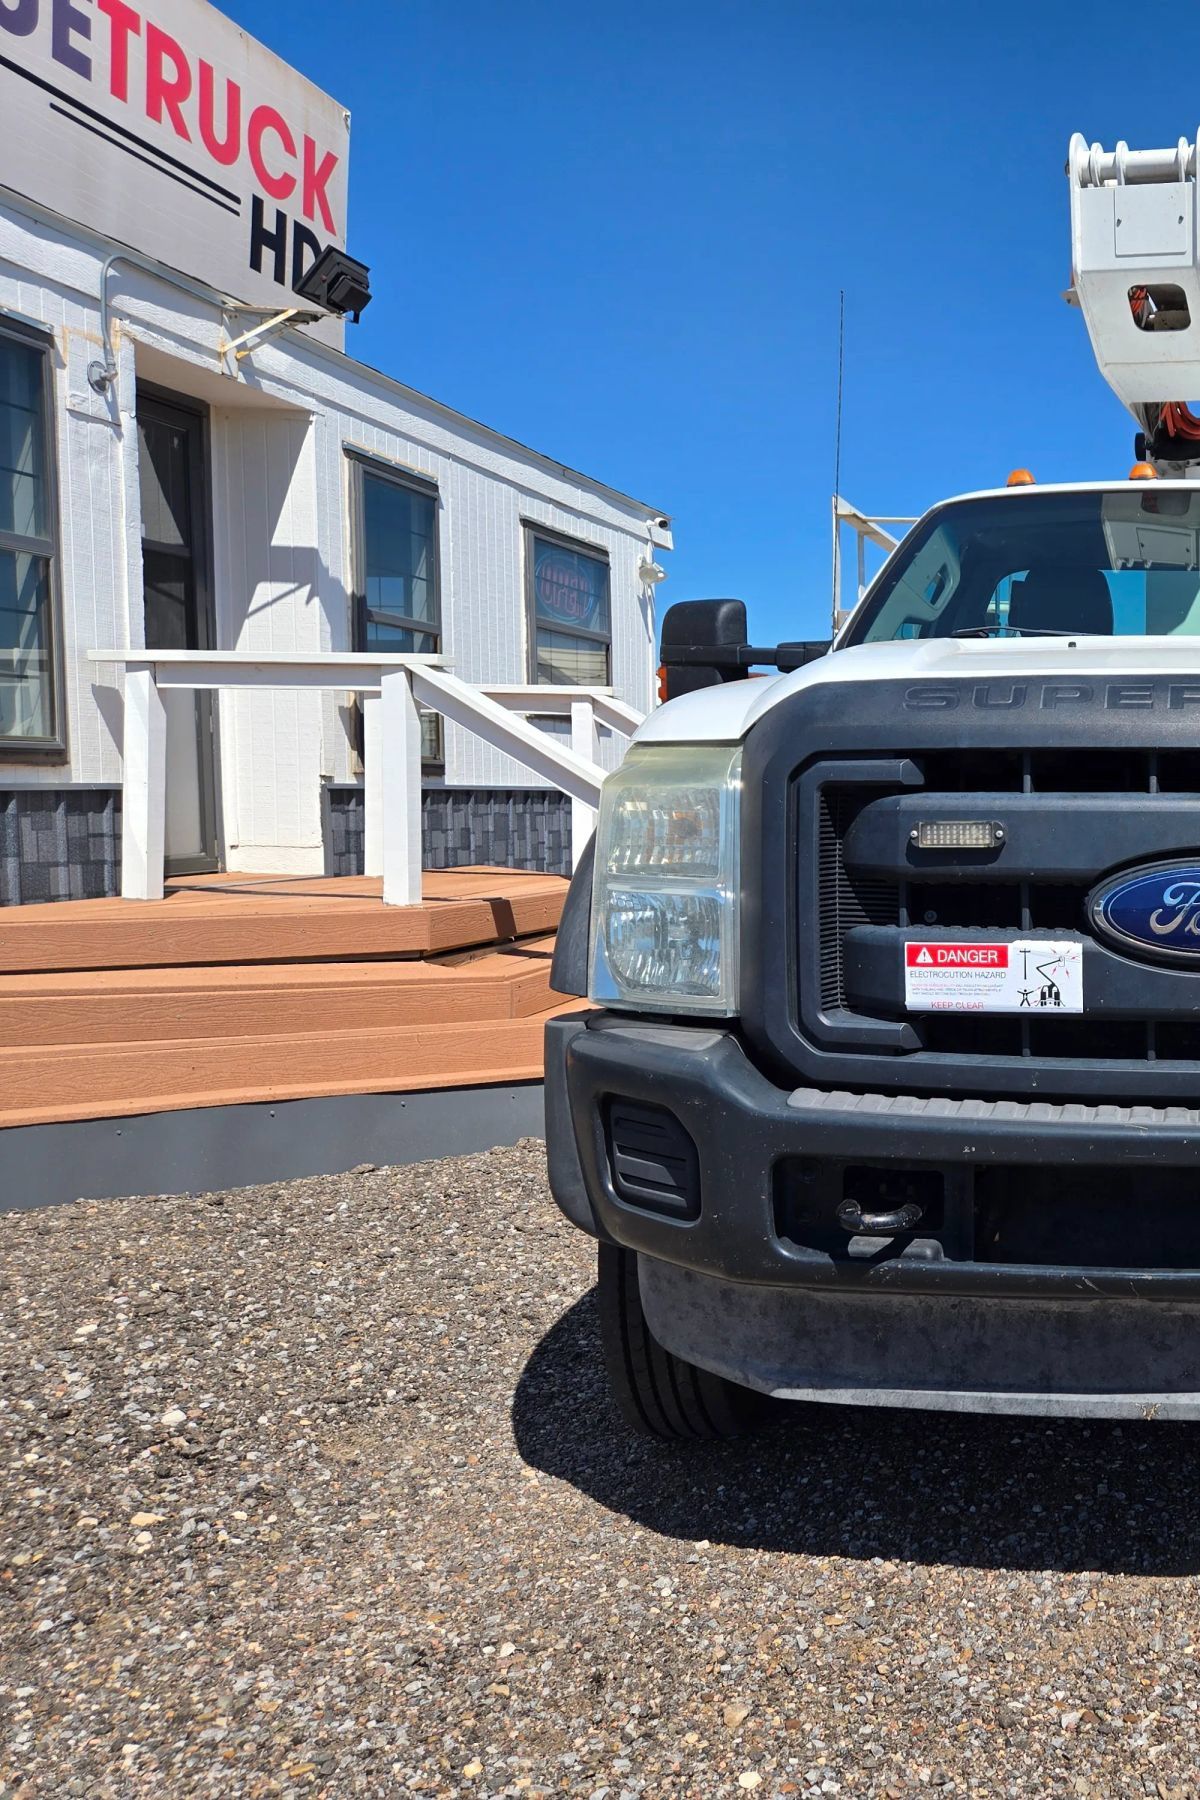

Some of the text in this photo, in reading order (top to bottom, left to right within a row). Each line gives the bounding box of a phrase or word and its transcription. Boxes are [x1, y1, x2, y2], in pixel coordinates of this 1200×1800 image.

[937, 949, 998, 964] DANGER
[910, 970, 1006, 979] ELECTROCUTION HAZARD
[931, 1001, 984, 1009] KEEP CLEAR
